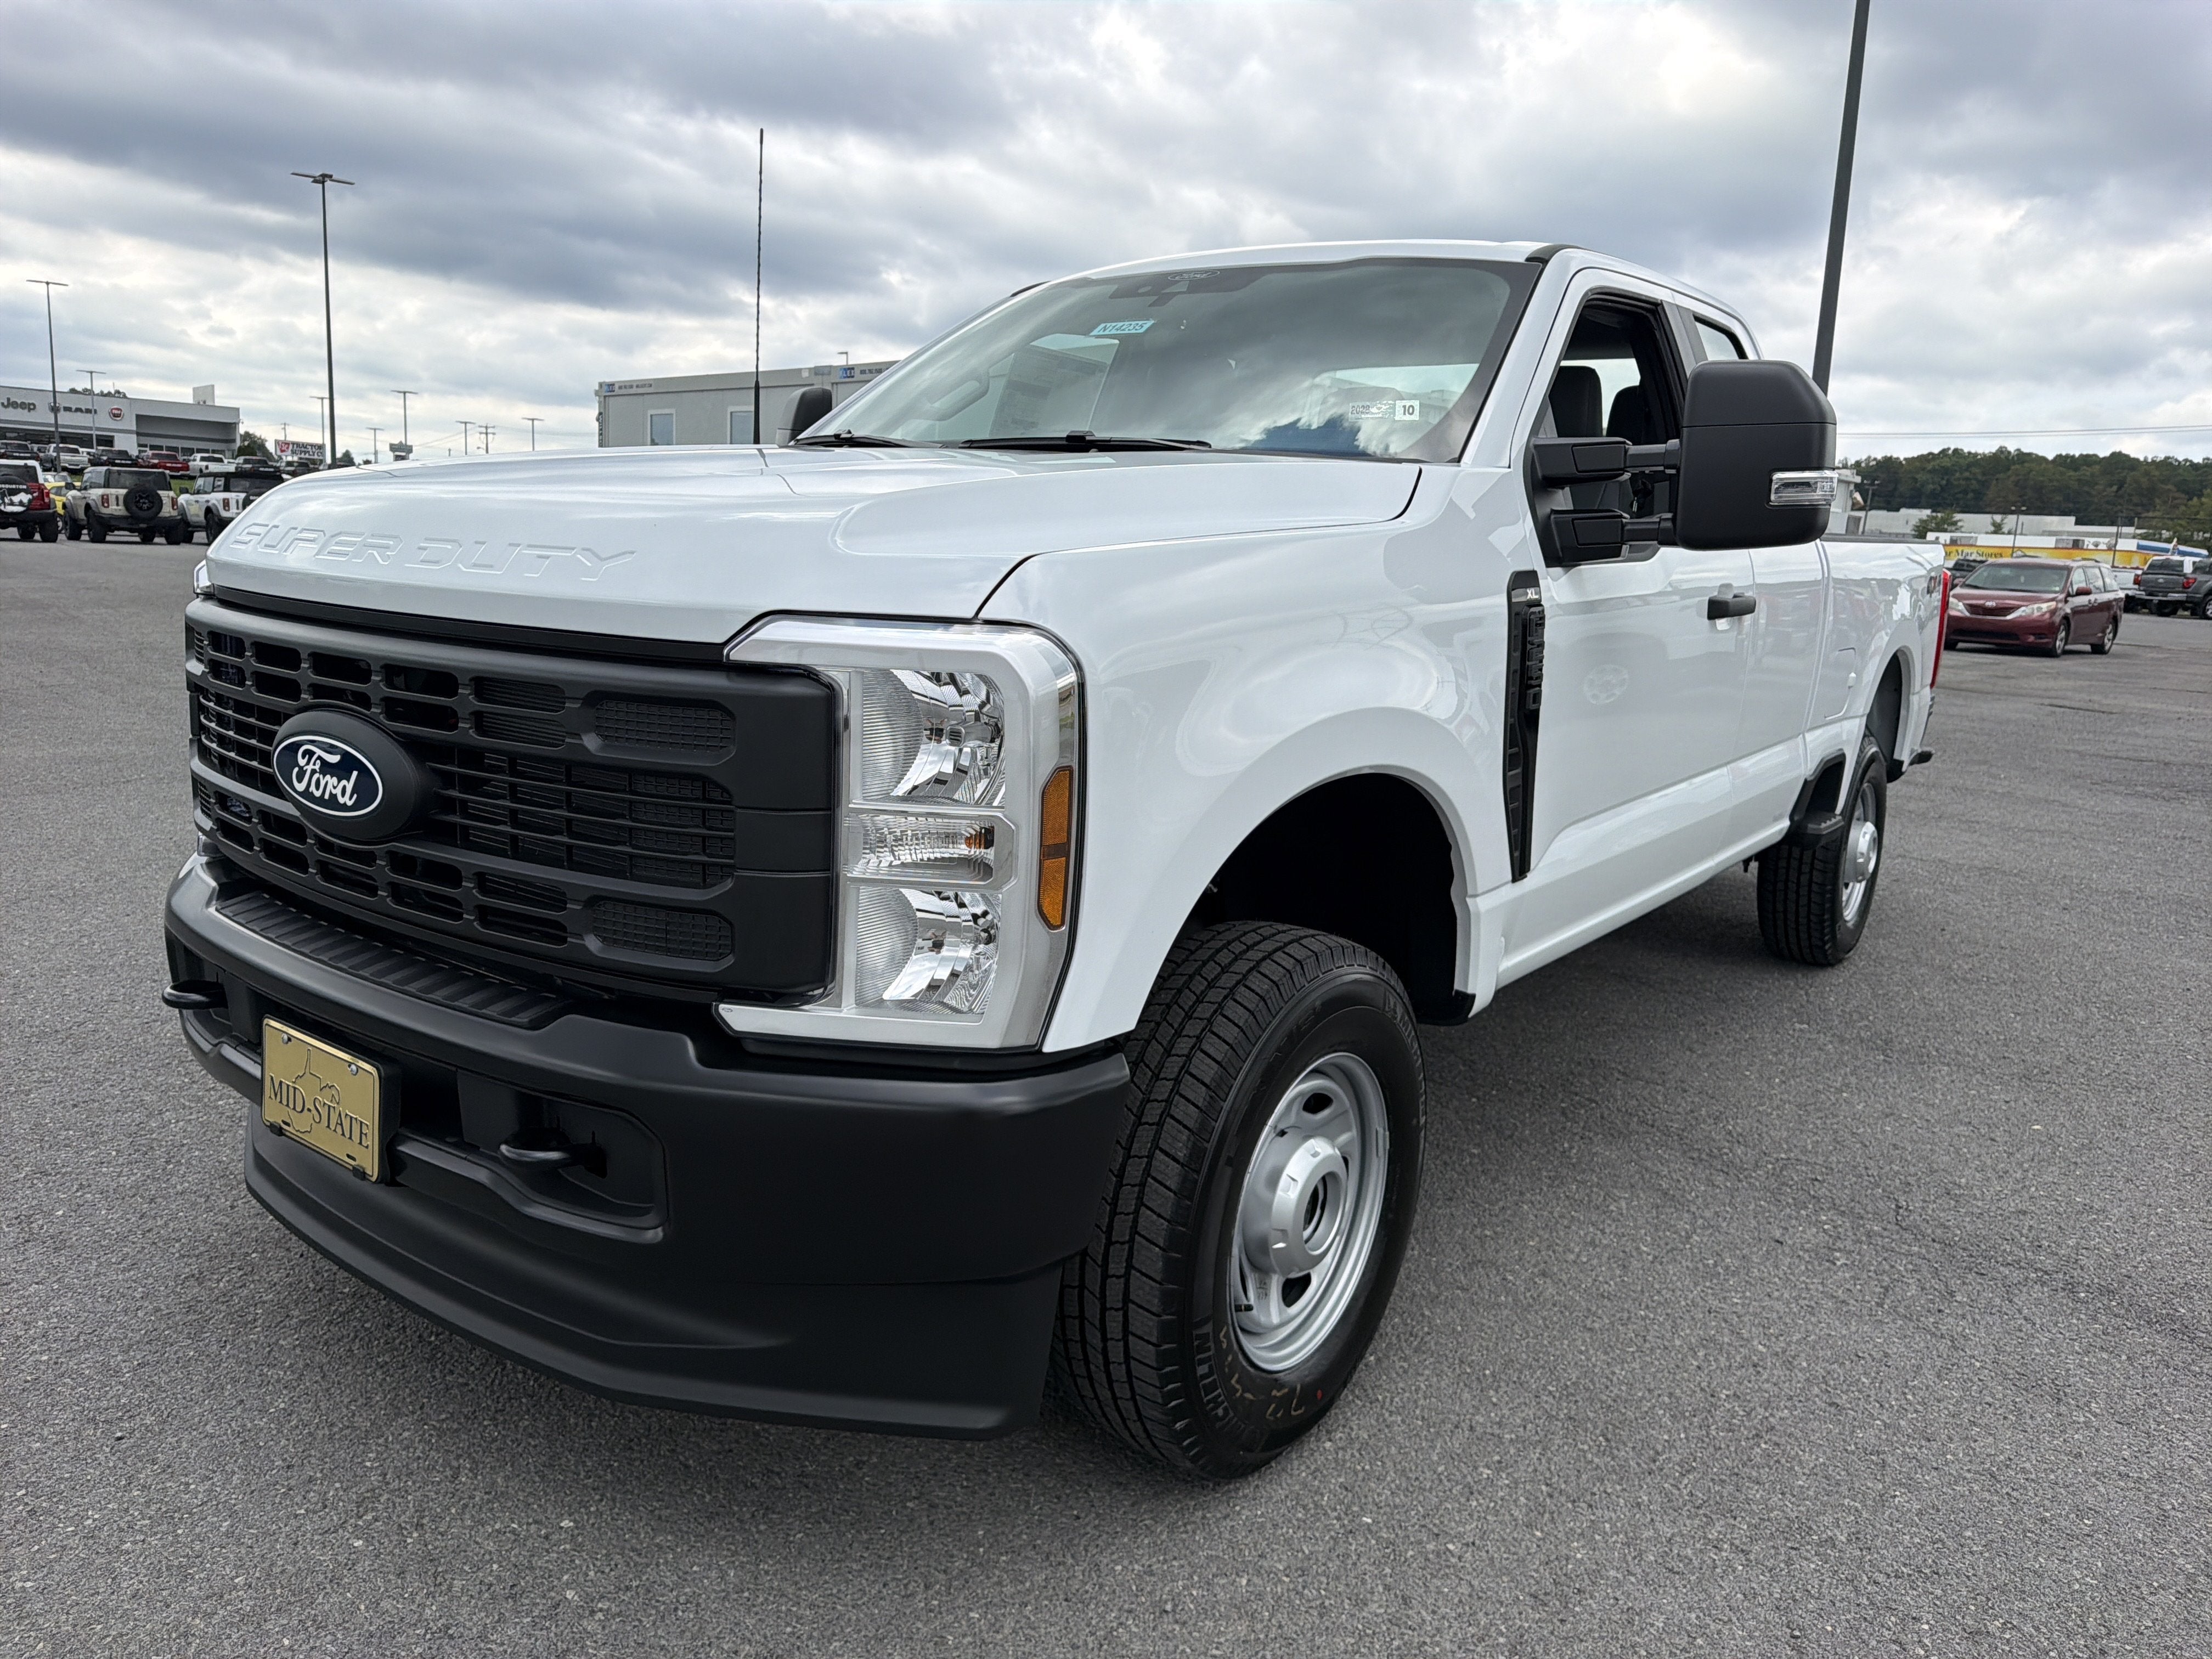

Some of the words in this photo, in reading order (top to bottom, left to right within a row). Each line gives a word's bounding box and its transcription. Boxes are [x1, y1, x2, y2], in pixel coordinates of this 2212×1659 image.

[1098, 322, 1148, 333] N14235
[1, 397, 36, 413] Jeep
[1402, 404, 1415, 416] 10
[229, 522, 404, 565] SUPER
[405, 537, 636, 581] DUTY
[1976, 549, 2004, 558] Stores
[1526, 588, 1539, 599] XL
[292, 744, 358, 806] Ford
[268, 1073, 370, 1149] MID-STATE
